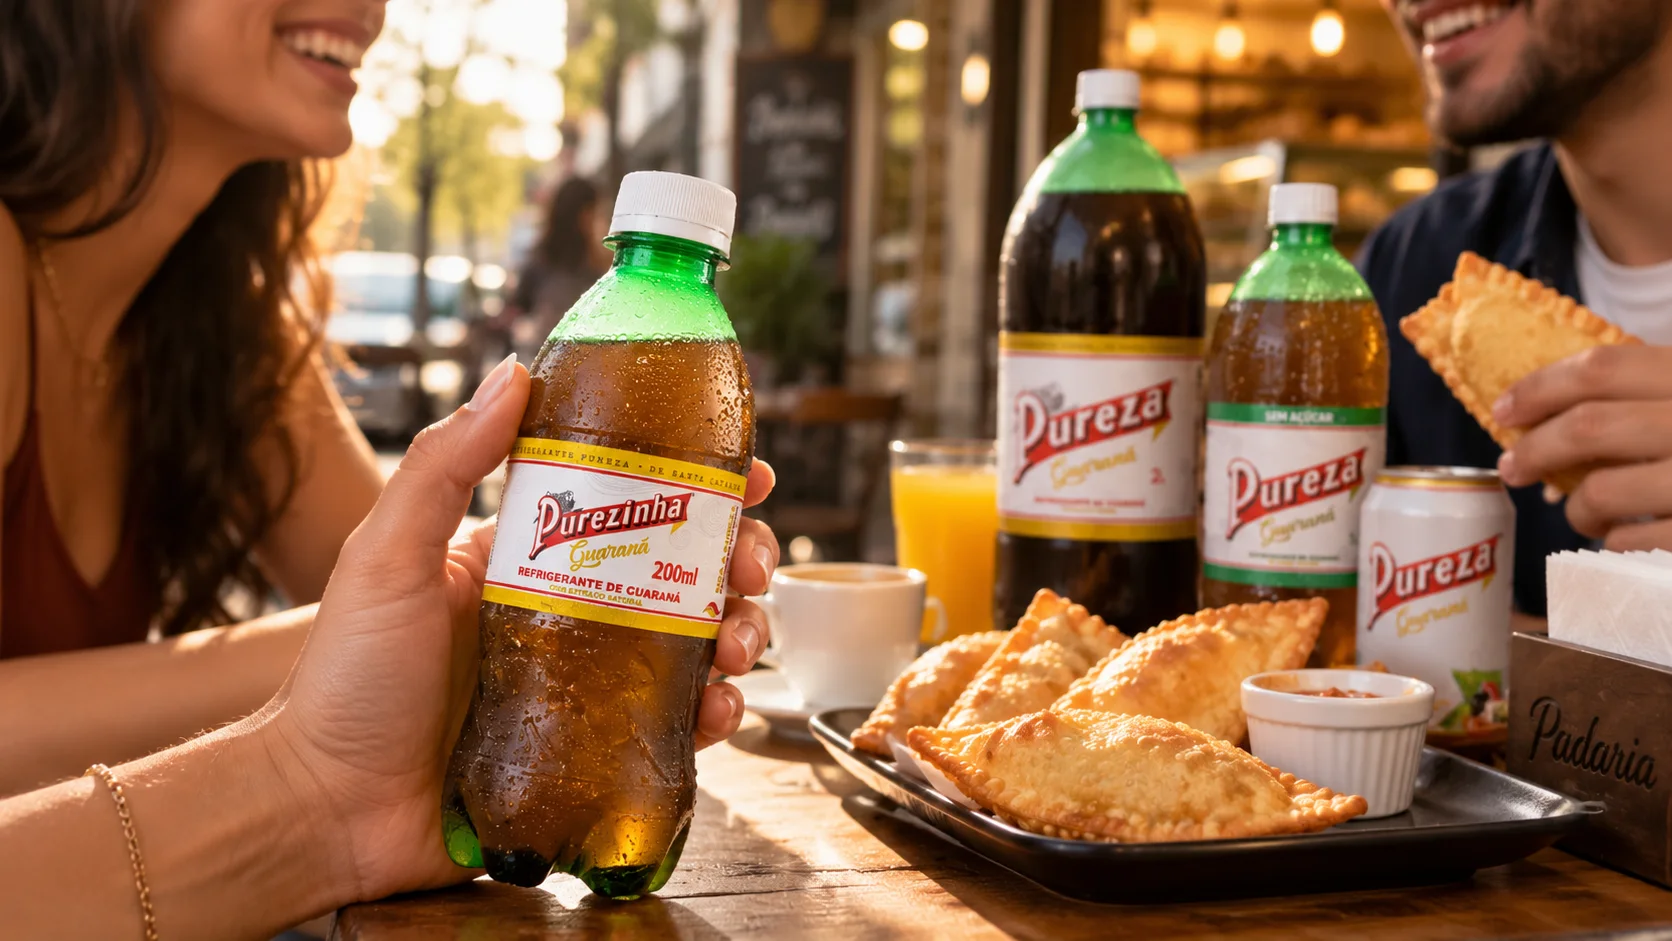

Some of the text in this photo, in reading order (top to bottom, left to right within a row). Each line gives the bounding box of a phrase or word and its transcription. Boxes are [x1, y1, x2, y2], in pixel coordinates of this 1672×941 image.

[1013, 387, 1165, 486] Pureza
[1265, 409, 1288, 423] SEM
[649, 465, 665, 475] DE
[1226, 455, 1360, 540] Pureza
[528, 493, 684, 560] Purezinha
[569, 536, 651, 572] Guaraná
[651, 560, 699, 586] 200ml
[517, 566, 604, 590] REFRIGERANTE
[606, 582, 624, 594] DE
[1367, 540, 1493, 631] Pureza
[1528, 696, 1657, 790] Padaria
